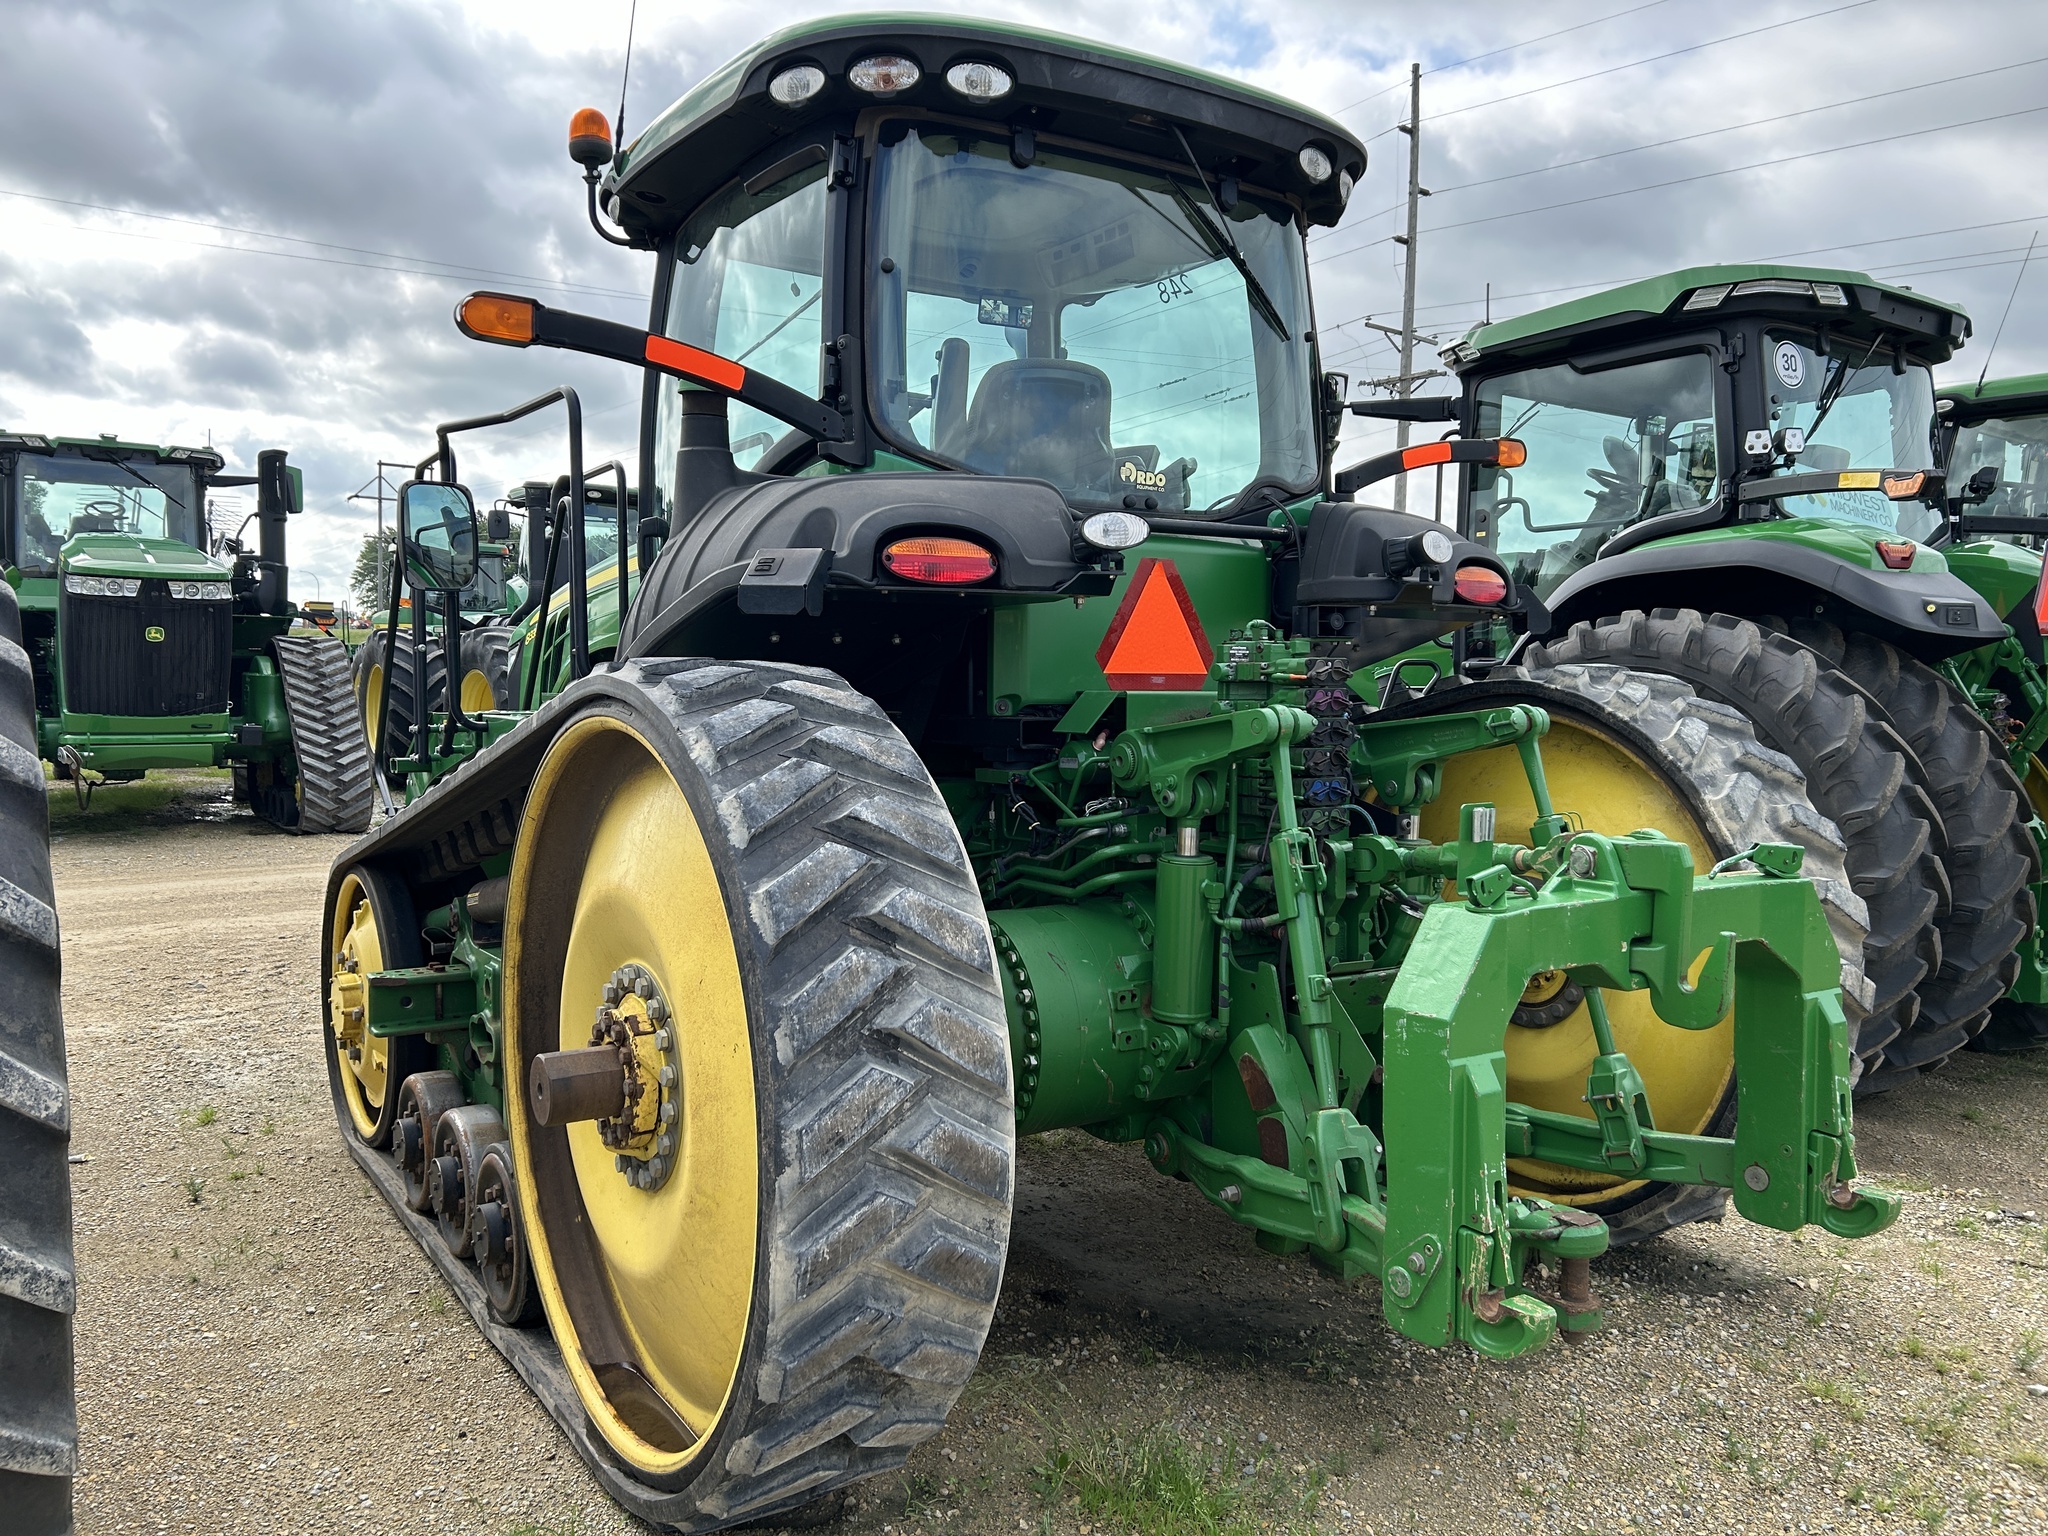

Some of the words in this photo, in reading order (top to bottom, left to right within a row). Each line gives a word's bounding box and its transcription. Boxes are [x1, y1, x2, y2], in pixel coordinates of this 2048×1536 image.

[1782, 353, 1797, 372] 30
[1136, 470, 1166, 486] RDO
[1829, 498, 1878, 523] MACHINERY
[1879, 513, 1892, 528] CO
